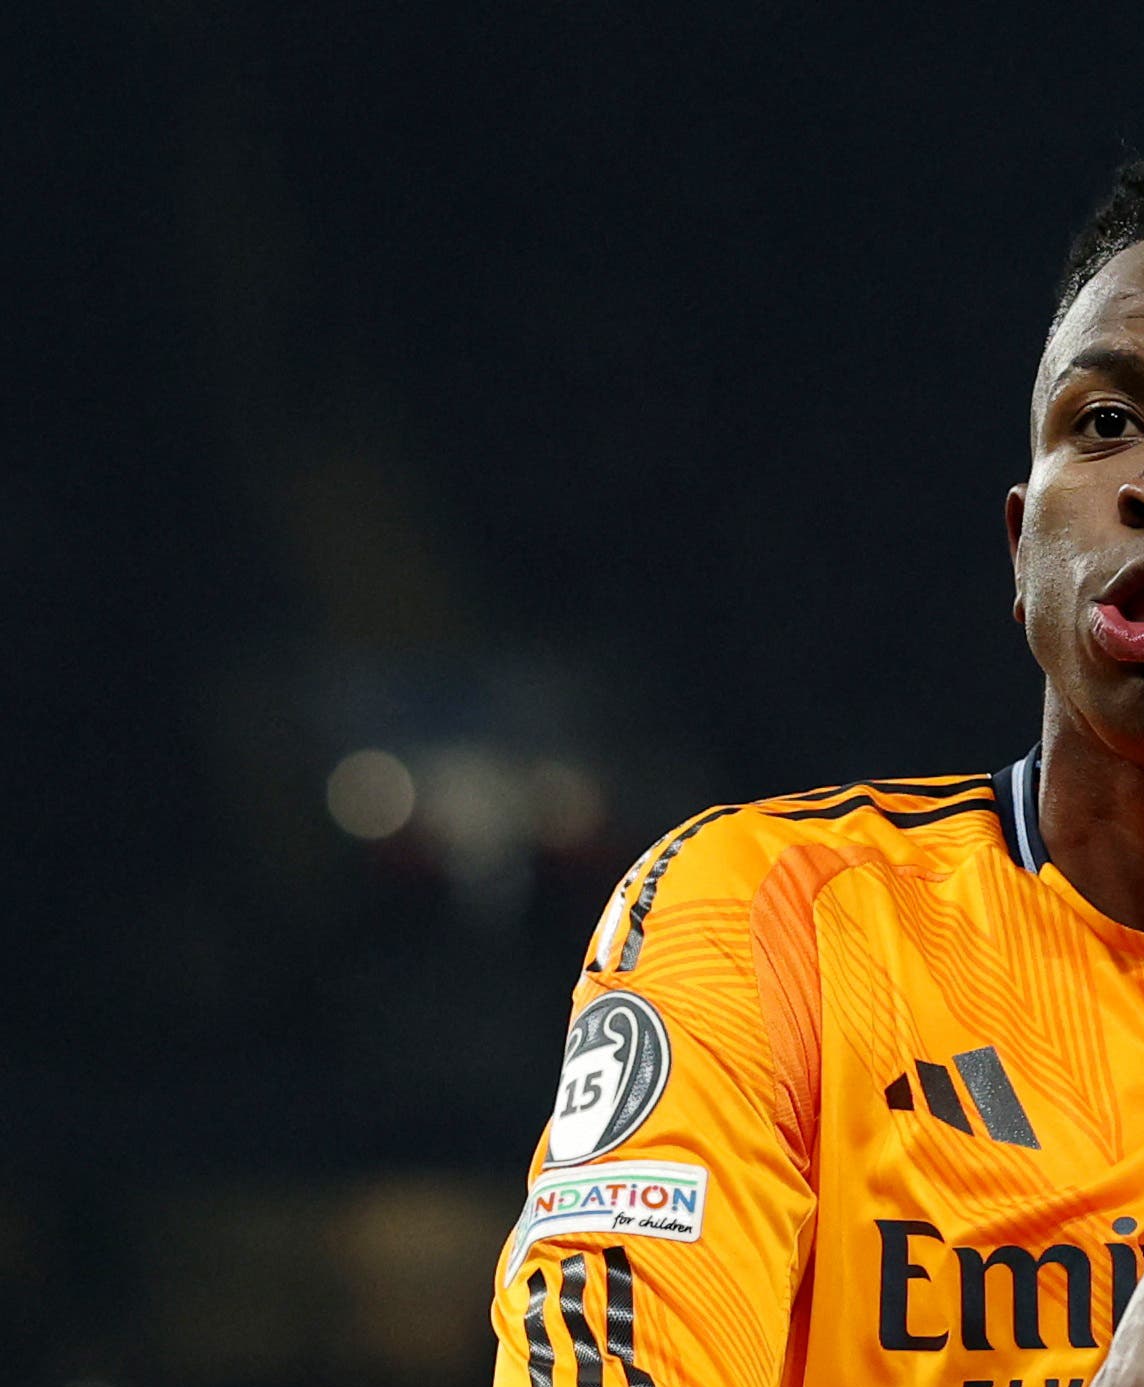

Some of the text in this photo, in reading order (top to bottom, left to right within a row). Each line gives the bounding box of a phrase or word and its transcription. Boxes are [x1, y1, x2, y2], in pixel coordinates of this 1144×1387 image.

[560, 1069, 603, 1118] 15
[533, 1183, 697, 1218] NDATION
[612, 1211, 693, 1234] for children
